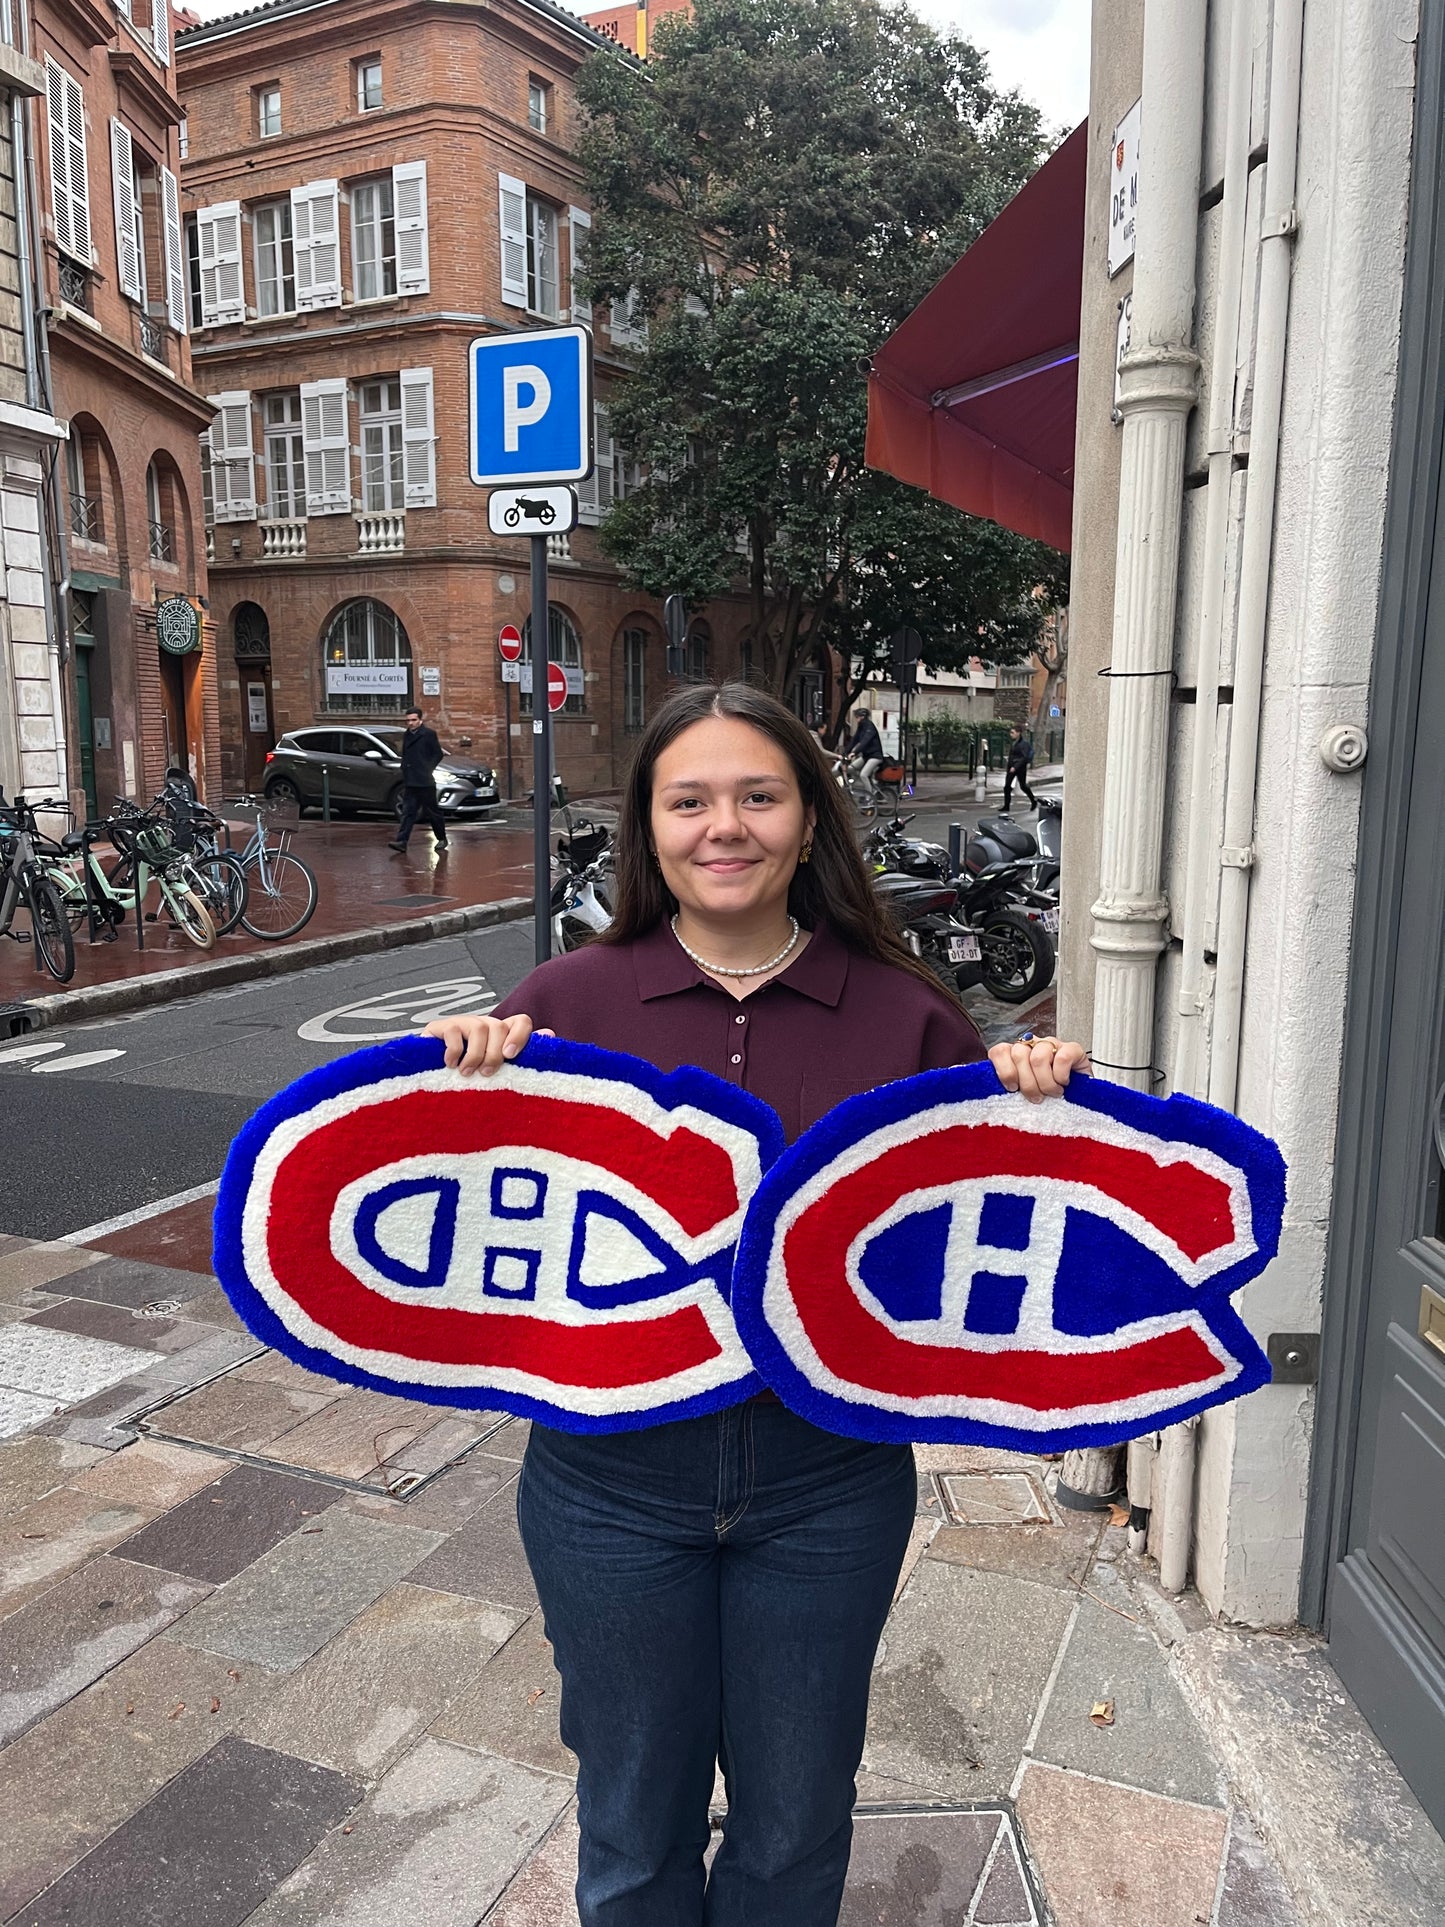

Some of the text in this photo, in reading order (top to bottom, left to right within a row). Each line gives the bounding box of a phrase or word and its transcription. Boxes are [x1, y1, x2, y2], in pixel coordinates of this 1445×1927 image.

[1113, 171, 1138, 228] DE M
[503, 364, 552, 453] P
